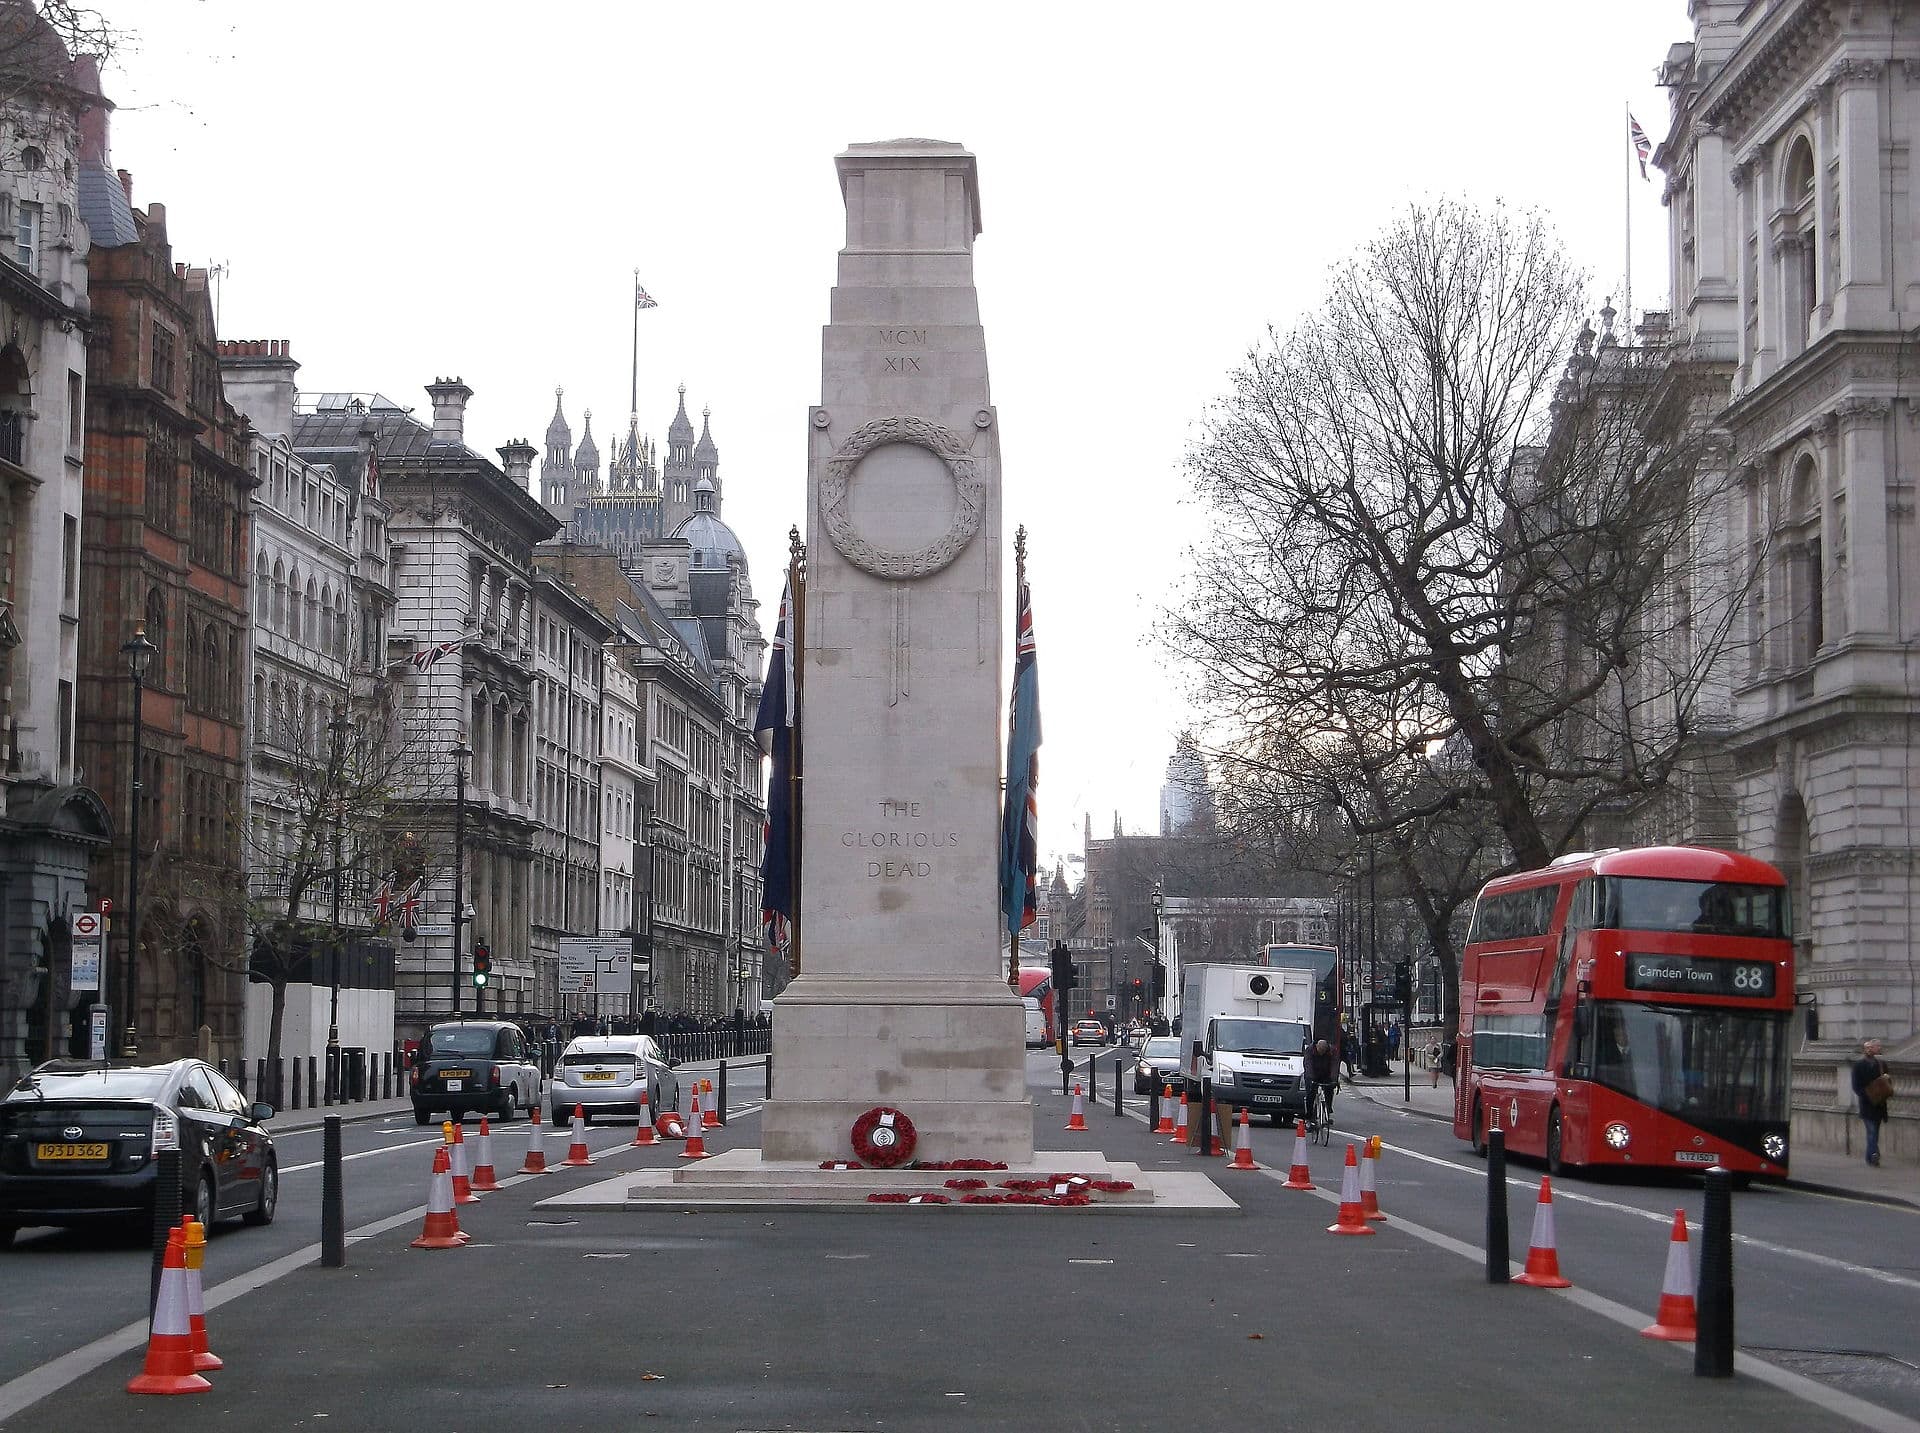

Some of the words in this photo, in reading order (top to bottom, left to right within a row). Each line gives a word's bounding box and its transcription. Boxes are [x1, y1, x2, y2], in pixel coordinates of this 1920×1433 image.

[879, 330, 927, 345] MCM
[884, 357, 921, 372] XIX
[878, 802, 921, 818] THE
[841, 832, 959, 848] GLORIOUS
[867, 862, 931, 878] DEAD
[101, 900, 109, 912] F
[1637, 964, 1682, 979] Camden
[1685, 967, 1713, 981] Town
[1733, 966, 1763, 989] 88
